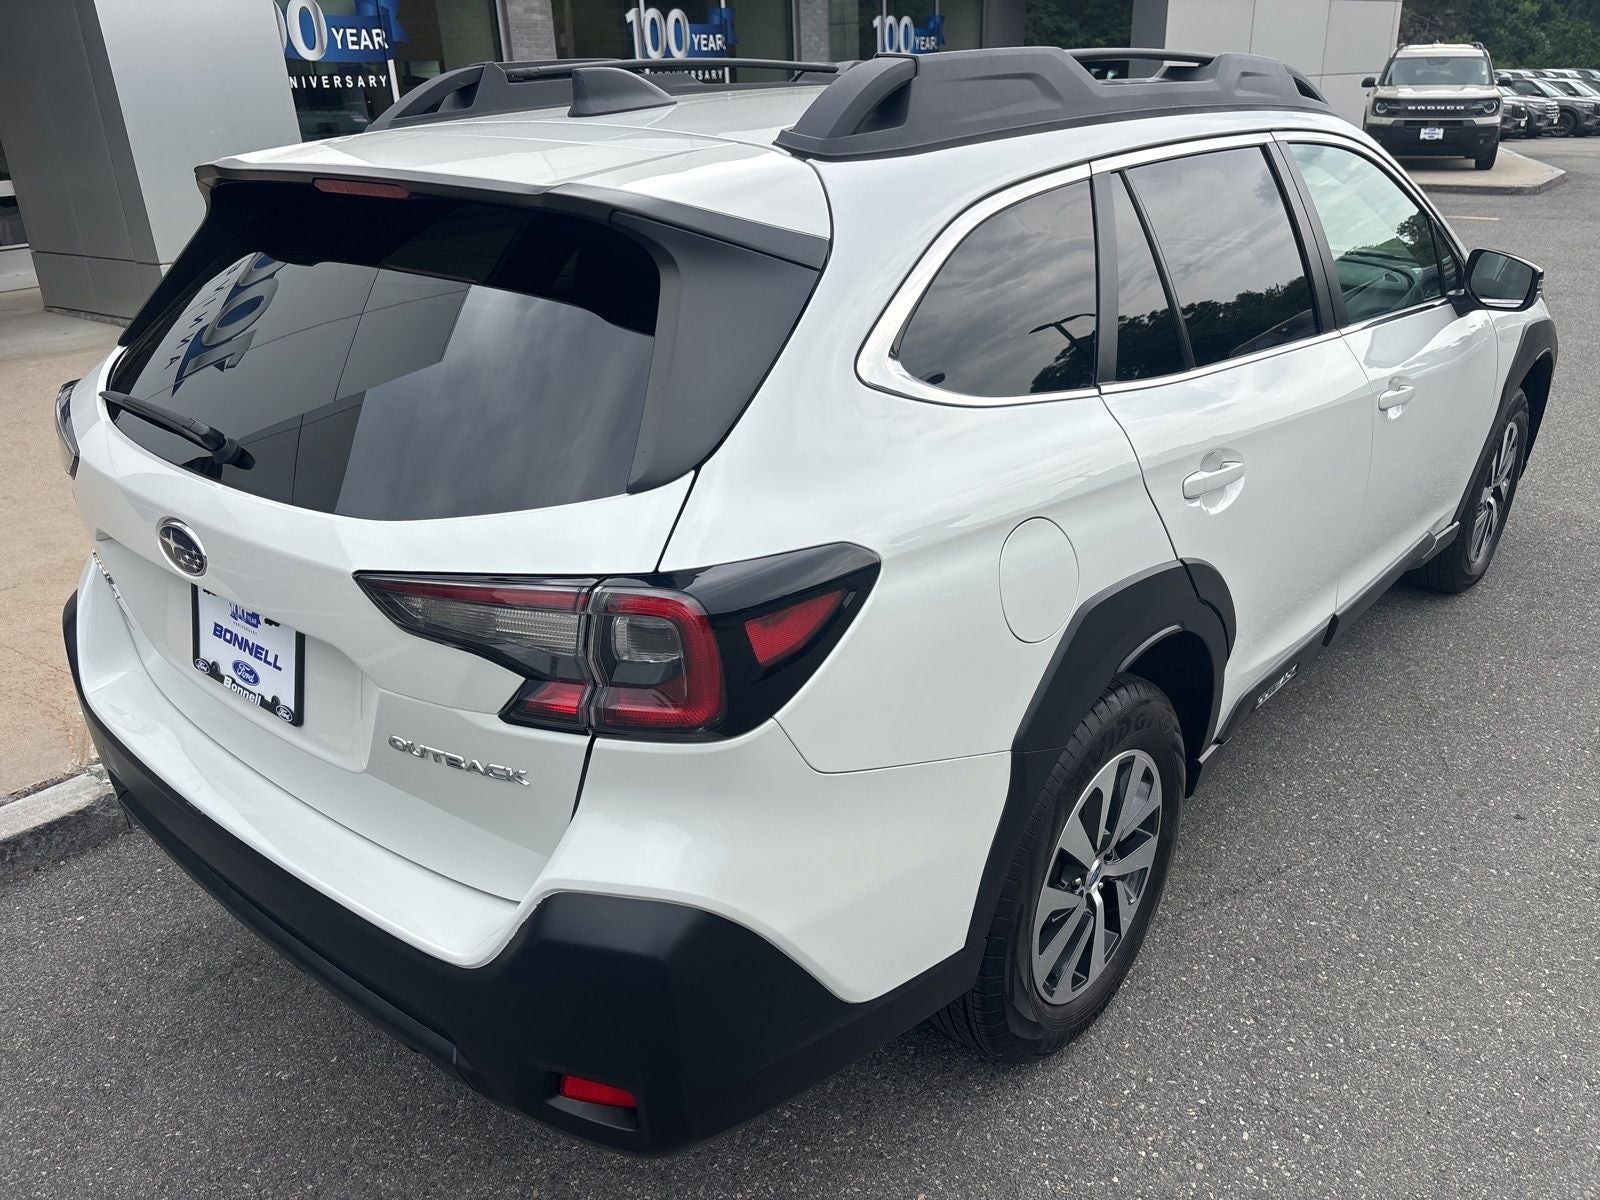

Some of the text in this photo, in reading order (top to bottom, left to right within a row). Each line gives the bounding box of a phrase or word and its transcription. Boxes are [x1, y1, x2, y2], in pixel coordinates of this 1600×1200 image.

[331, 27, 389, 50] YEAR
[625, 7, 726, 59] 100 YEAR
[872, 15, 938, 53] 100 YEAR
[213, 621, 282, 672] BONNELL
[223, 674, 262, 706] Bonnell
[238, 664, 255, 684] Ford
[388, 734, 531, 786] OUTBACK
